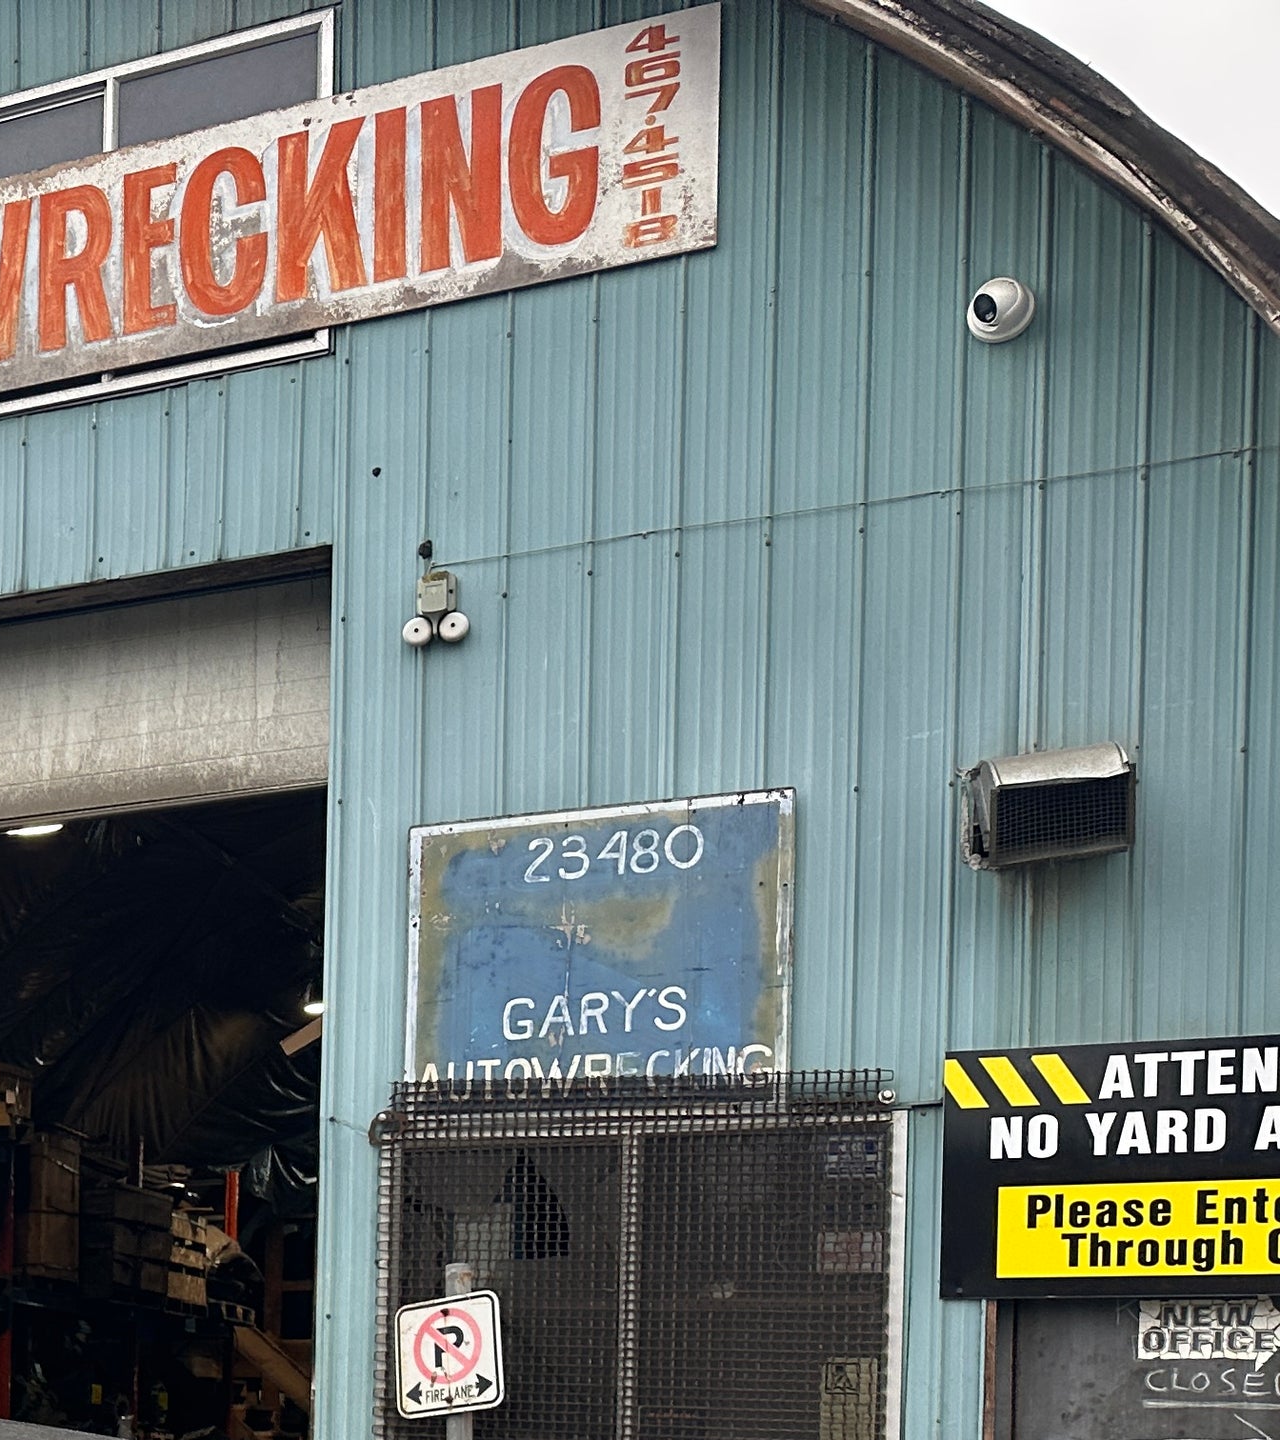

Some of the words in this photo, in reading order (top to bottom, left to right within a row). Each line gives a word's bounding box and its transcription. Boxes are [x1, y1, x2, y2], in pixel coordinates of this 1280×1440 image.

[523, 823, 706, 884] 23480
[501, 985, 688, 1042] GARY'S
[1098, 1047, 1279, 1100] ATTEN
[989, 1113, 1059, 1160] NO
[1085, 1108, 1227, 1156] YARD
[1026, 1193, 1172, 1229] Please
[1061, 1229, 1243, 1272] Through
[1162, 1305, 1255, 1327] NEW
[1142, 1327, 1275, 1352] OFFICE
[425, 1388, 446, 1404] FIRE
